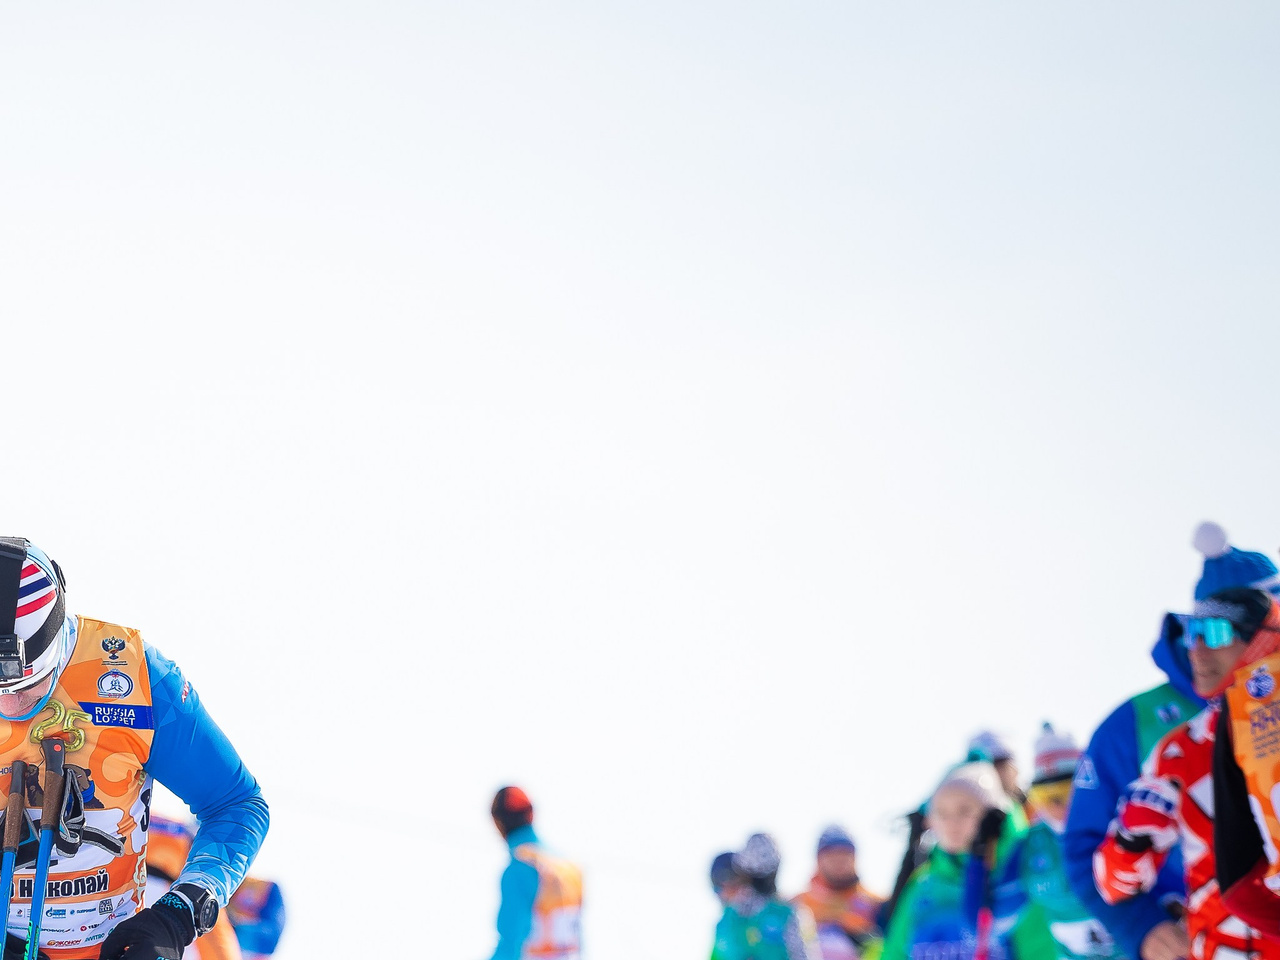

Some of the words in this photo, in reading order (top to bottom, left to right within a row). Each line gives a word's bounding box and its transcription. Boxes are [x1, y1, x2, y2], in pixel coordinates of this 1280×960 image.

[94, 706, 136, 718] RUSSIA
[95, 715, 136, 726] LOPPET
[19, 869, 110, 898] Нколай
